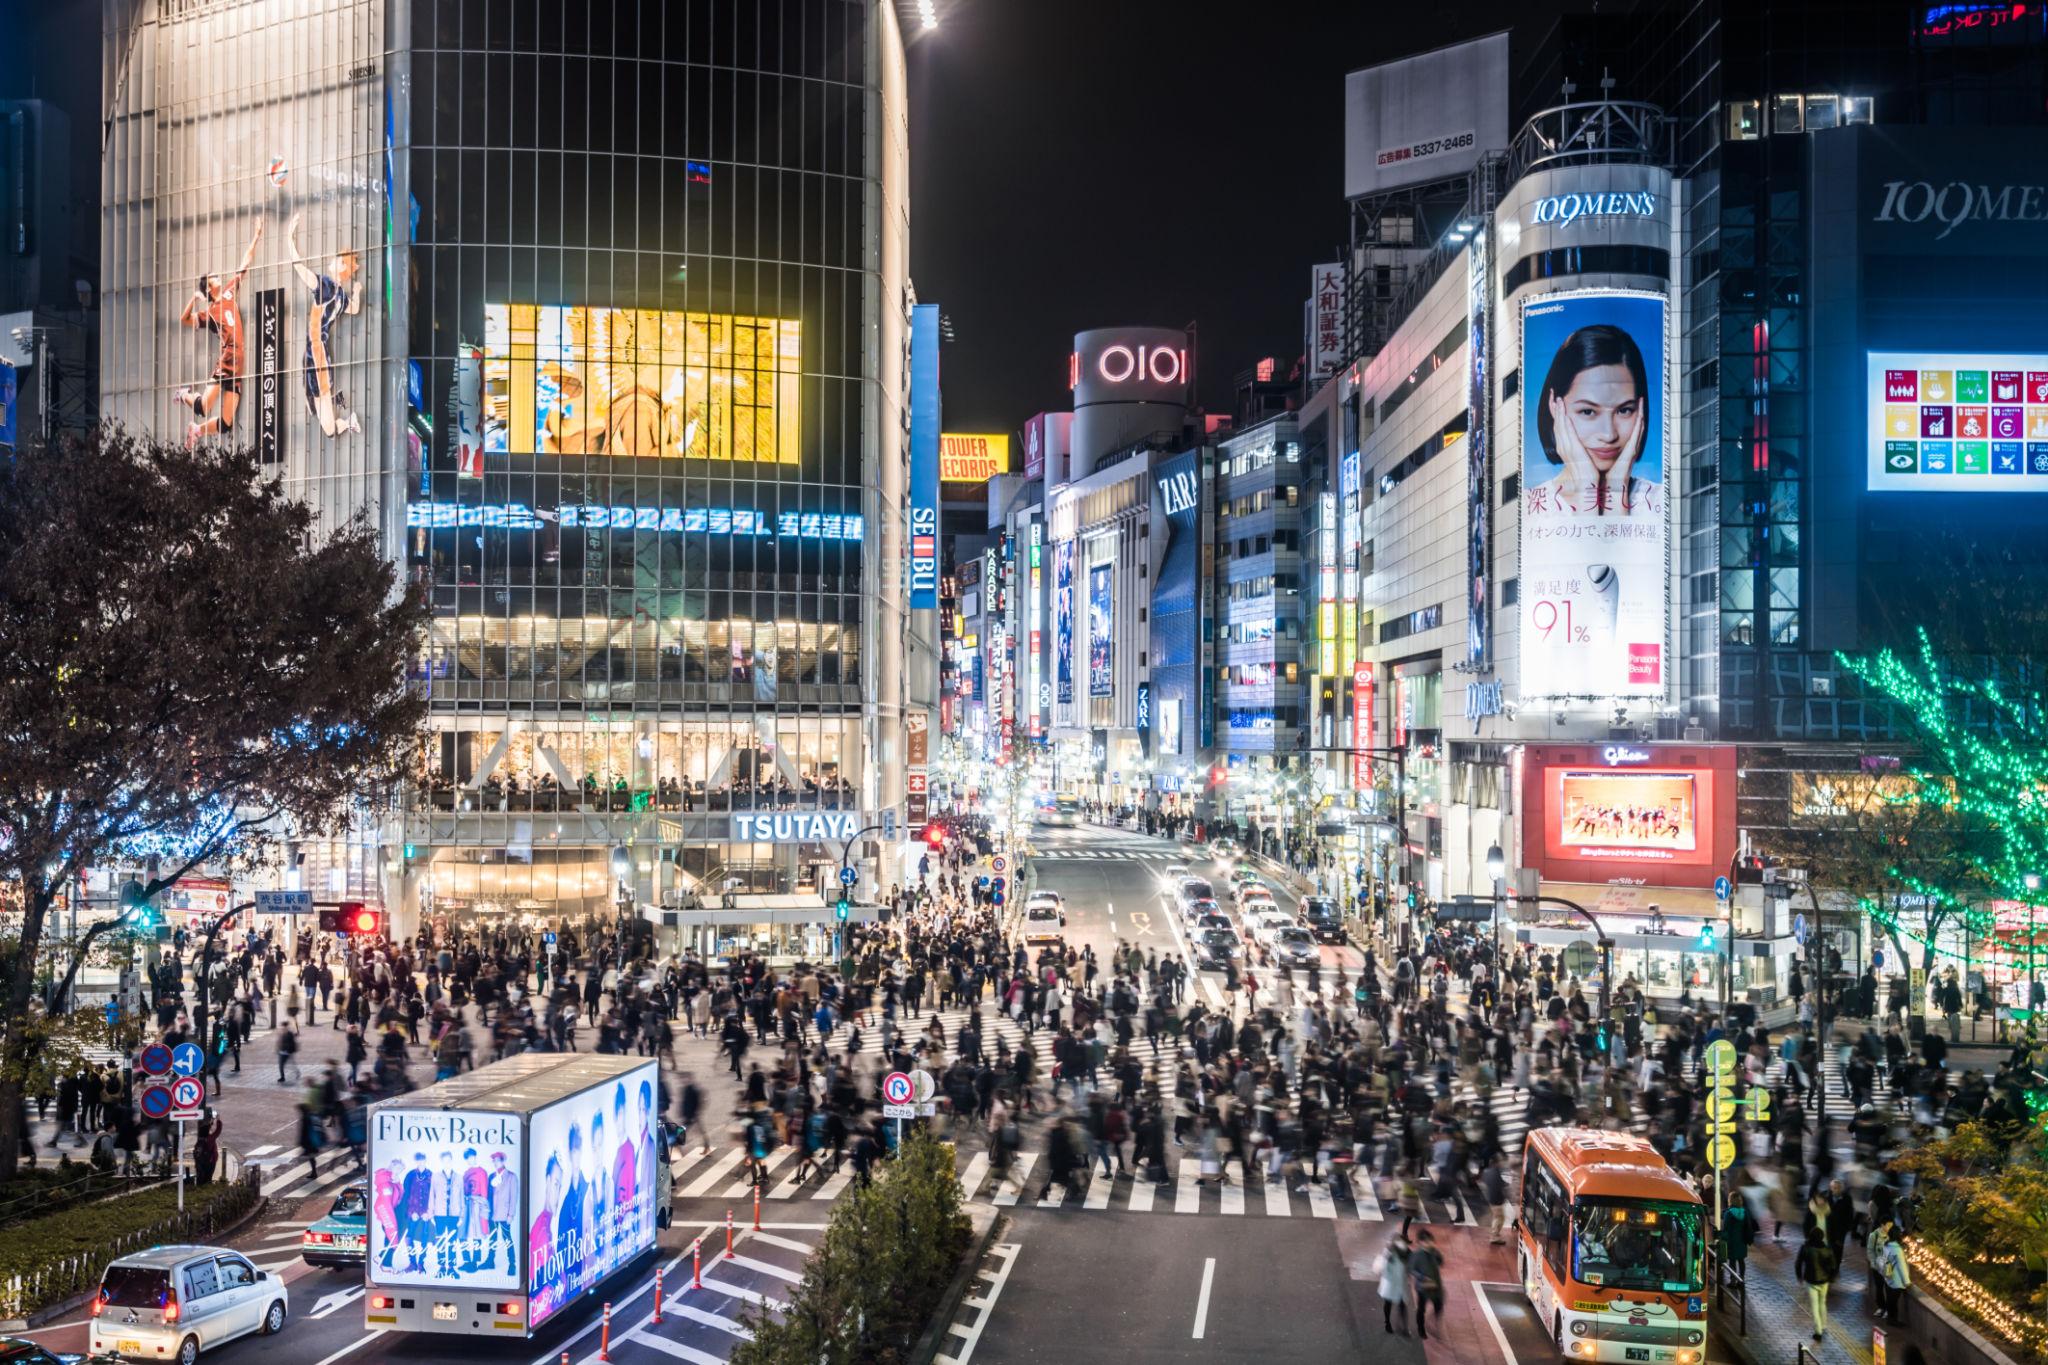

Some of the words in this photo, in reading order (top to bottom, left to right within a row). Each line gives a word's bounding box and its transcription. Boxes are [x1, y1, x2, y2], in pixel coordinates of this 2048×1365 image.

[1414, 133, 1473, 157] 5337-2468
[1532, 192, 1655, 229] 109MEN'S
[1873, 181, 2048, 240] 109ME
[1319, 271, 1339, 352] 大和証券
[1525, 304, 1564, 318] Panasonic
[263, 304, 275, 450] いざ、全国の頂きへ。
[942, 437, 988, 457] TOWER
[943, 459, 998, 479] ECORDS
[1159, 469, 1197, 515] ZARA
[1527, 483, 1662, 515] 深く、美しく。
[1528, 523, 1661, 540] イオンの力で、深層保湿。
[912, 508, 934, 592] SEIBU
[987, 548, 997, 611] KARAOKE
[1534, 578, 1582, 596] 満足度
[1533, 600, 1591, 643] 91%
[1139, 689, 1149, 727] ZARA
[911, 776, 925, 790] 本
[736, 814, 858, 840] TSUTAYA
[260, 894, 308, 905] 渋谷駅前
[885, 1107, 913, 1117] ここから
[377, 1114, 516, 1146] FlowBack
